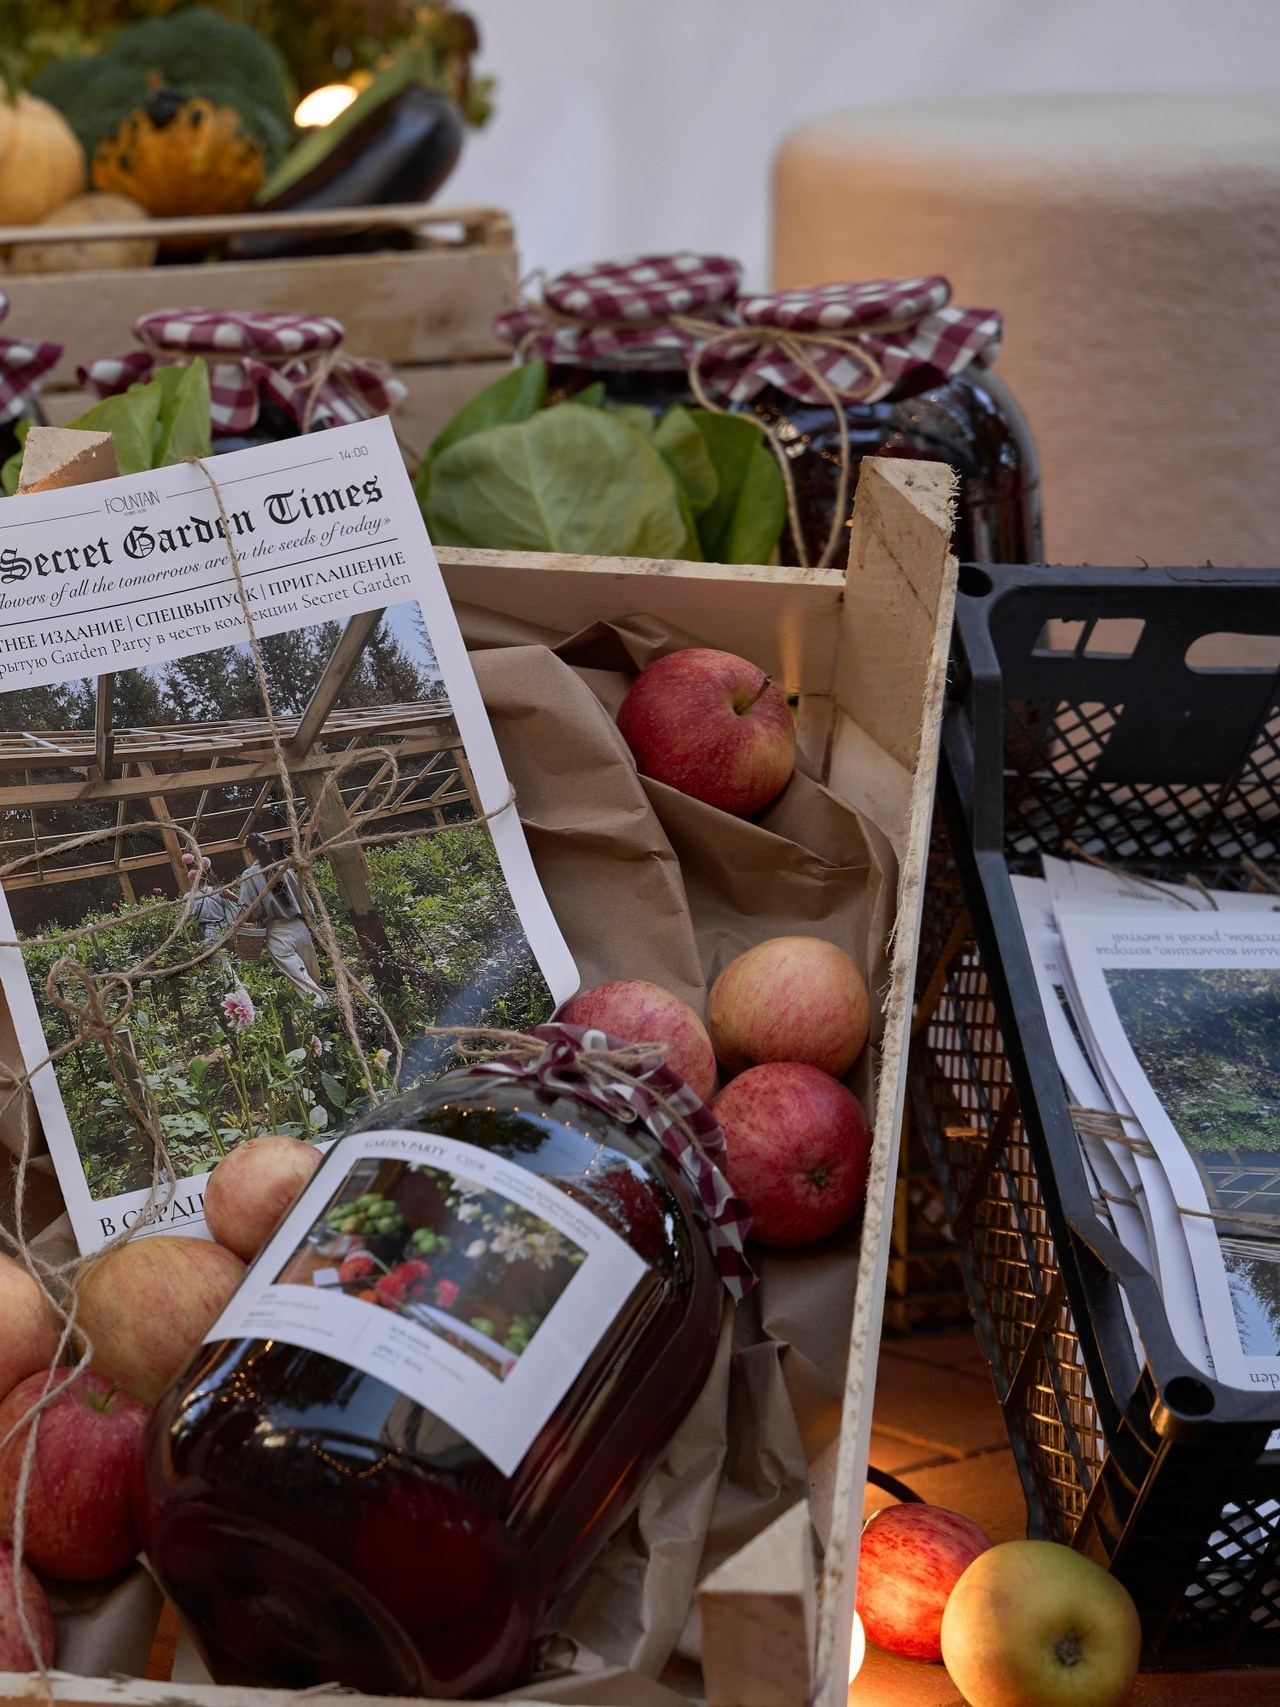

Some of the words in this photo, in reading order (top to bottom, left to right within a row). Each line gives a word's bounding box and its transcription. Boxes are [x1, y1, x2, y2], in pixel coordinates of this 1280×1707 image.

[338, 445, 369, 461] 14:00
[123, 510, 256, 560] Garden
[263, 475, 383, 525] Times
[39, 618, 126, 648] ИЗДАНИЕ
[135, 587, 259, 628] СПЕЦВЫПУСК
[267, 551, 406, 597] ПРИГЛАШЕНИЕ
[49, 582, 70, 608] of
[69, 578, 90, 599] all
[92, 575, 116, 594] the
[118, 562, 201, 589] tomorrows
[204, 554, 231, 570] are
[252, 539, 276, 558] the
[278, 528, 317, 553] seeds
[319, 521, 340, 547] of
[51, 643, 109, 666] Garden
[111, 637, 152, 654] Party
[156, 634, 166, 645] в
[168, 623, 211, 642] честь
[301, 588, 350, 609] Secret
[352, 572, 412, 596] Garden
[1178, 929, 1221, 944] росой
[98, 1216, 117, 1238] В
